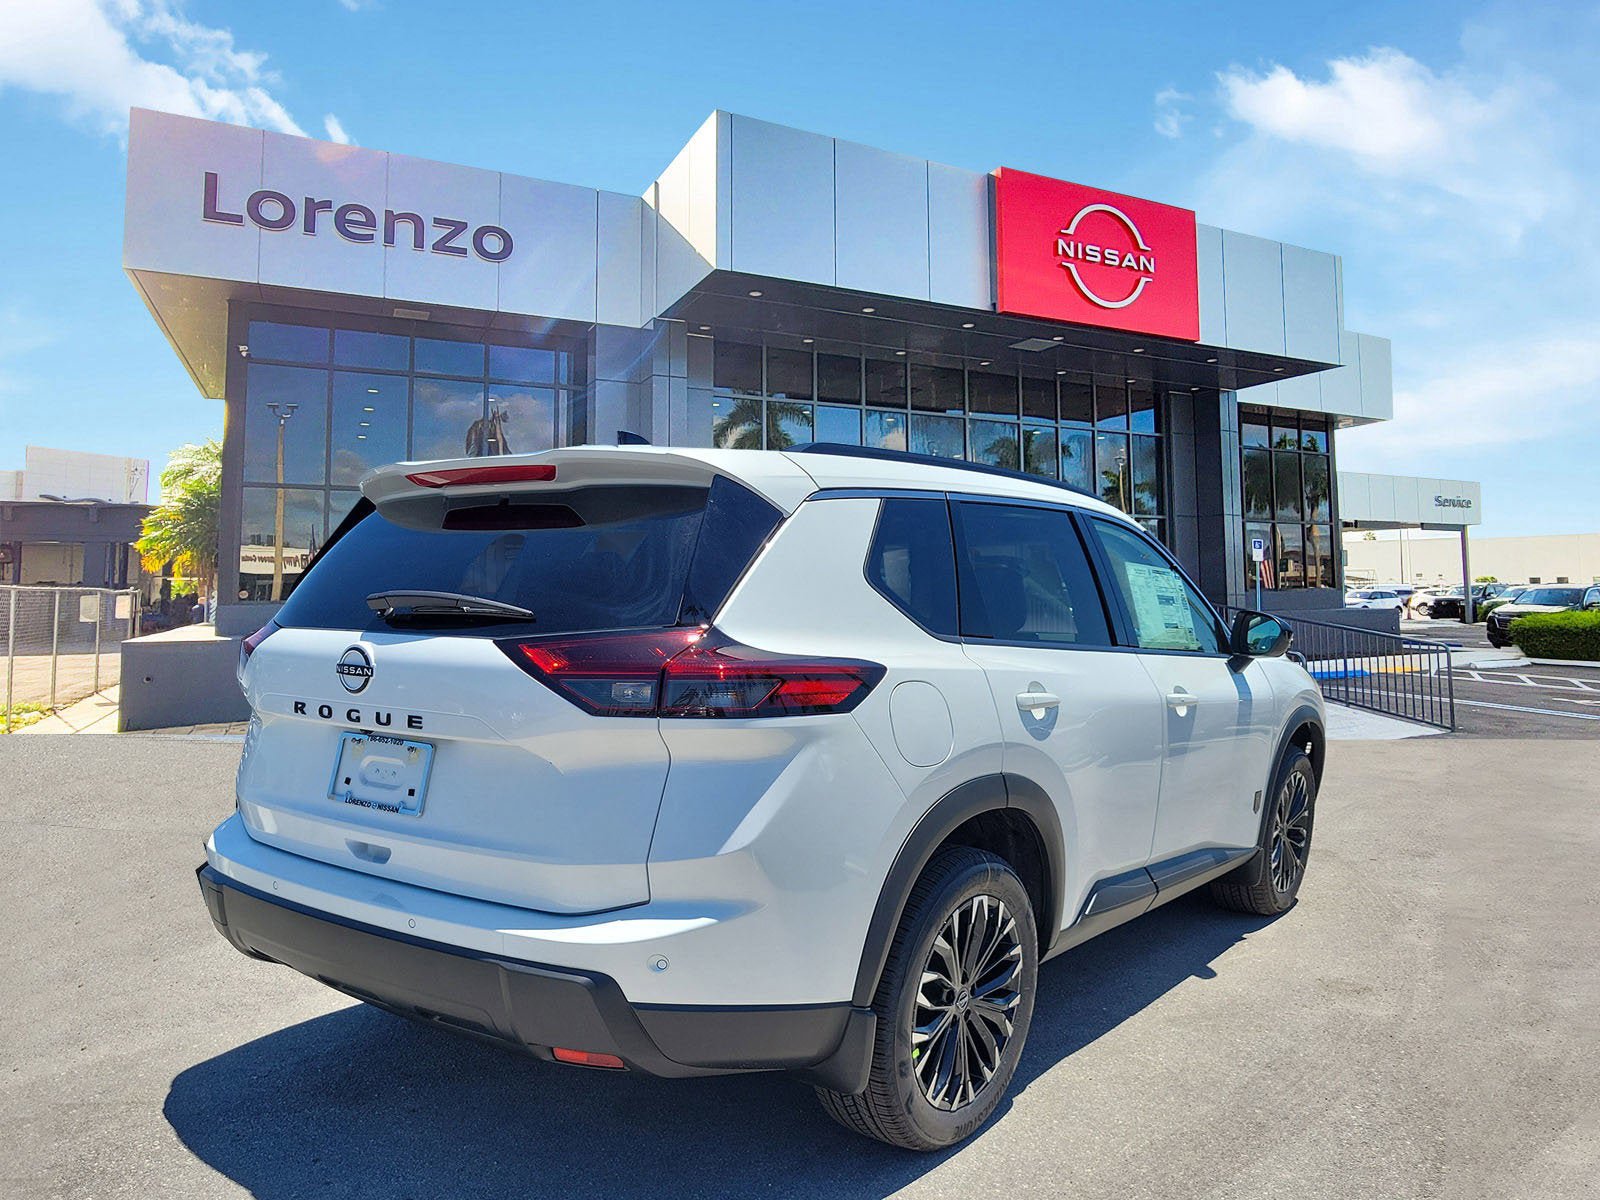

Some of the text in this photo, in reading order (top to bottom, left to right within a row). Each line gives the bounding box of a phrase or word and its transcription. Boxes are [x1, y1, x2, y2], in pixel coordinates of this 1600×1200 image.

[203, 171, 514, 262] Lorenzo
[1057, 238, 1155, 273] NISSAN
[1434, 495, 1472, 509] Service
[336, 665, 373, 677] NISSAN
[293, 701, 423, 729] ROGUE
[344, 797, 400, 814] LORENZO NISSAN
